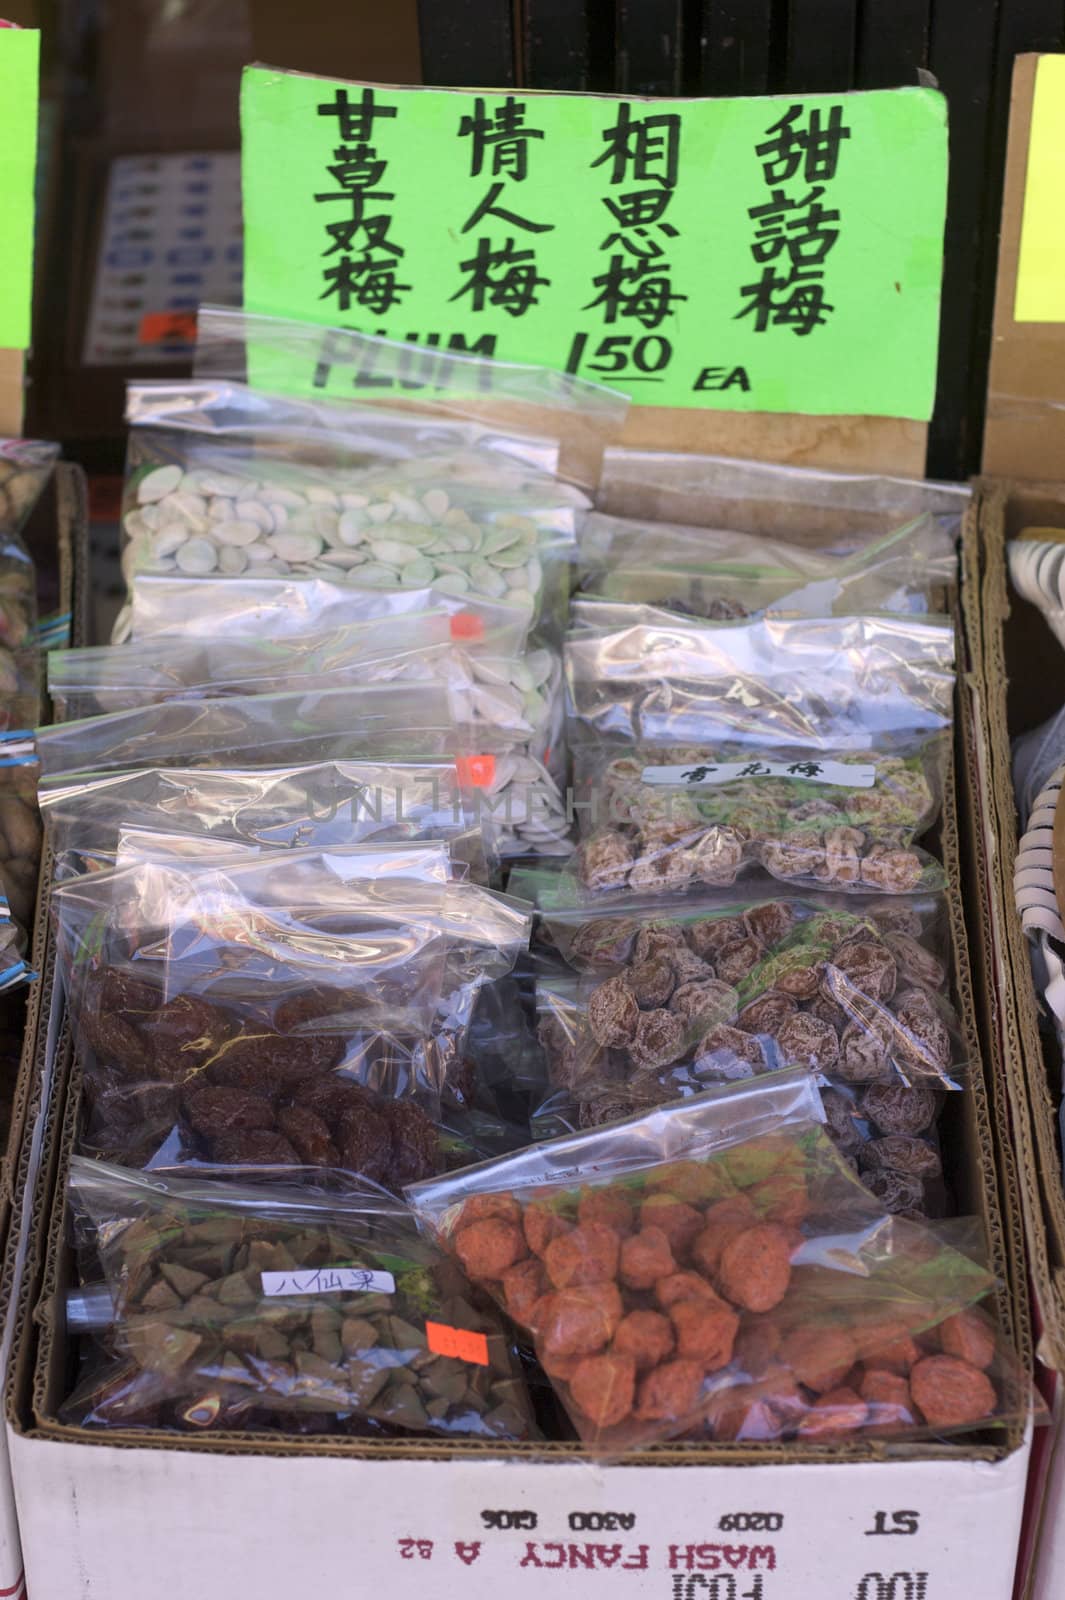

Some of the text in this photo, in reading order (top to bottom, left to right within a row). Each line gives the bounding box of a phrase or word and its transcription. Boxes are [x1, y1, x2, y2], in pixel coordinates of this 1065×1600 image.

[314, 88, 412, 315] 甘草双梅
[448, 97, 556, 317] 情人梅
[580, 102, 688, 329] 相思梅
[692, 366, 751, 392] EA
[864, 1511, 921, 1535] ST
[454, 1541, 482, 1566] A
[520, 1542, 650, 1570] FANCY
[668, 1545, 777, 1570] WASH
